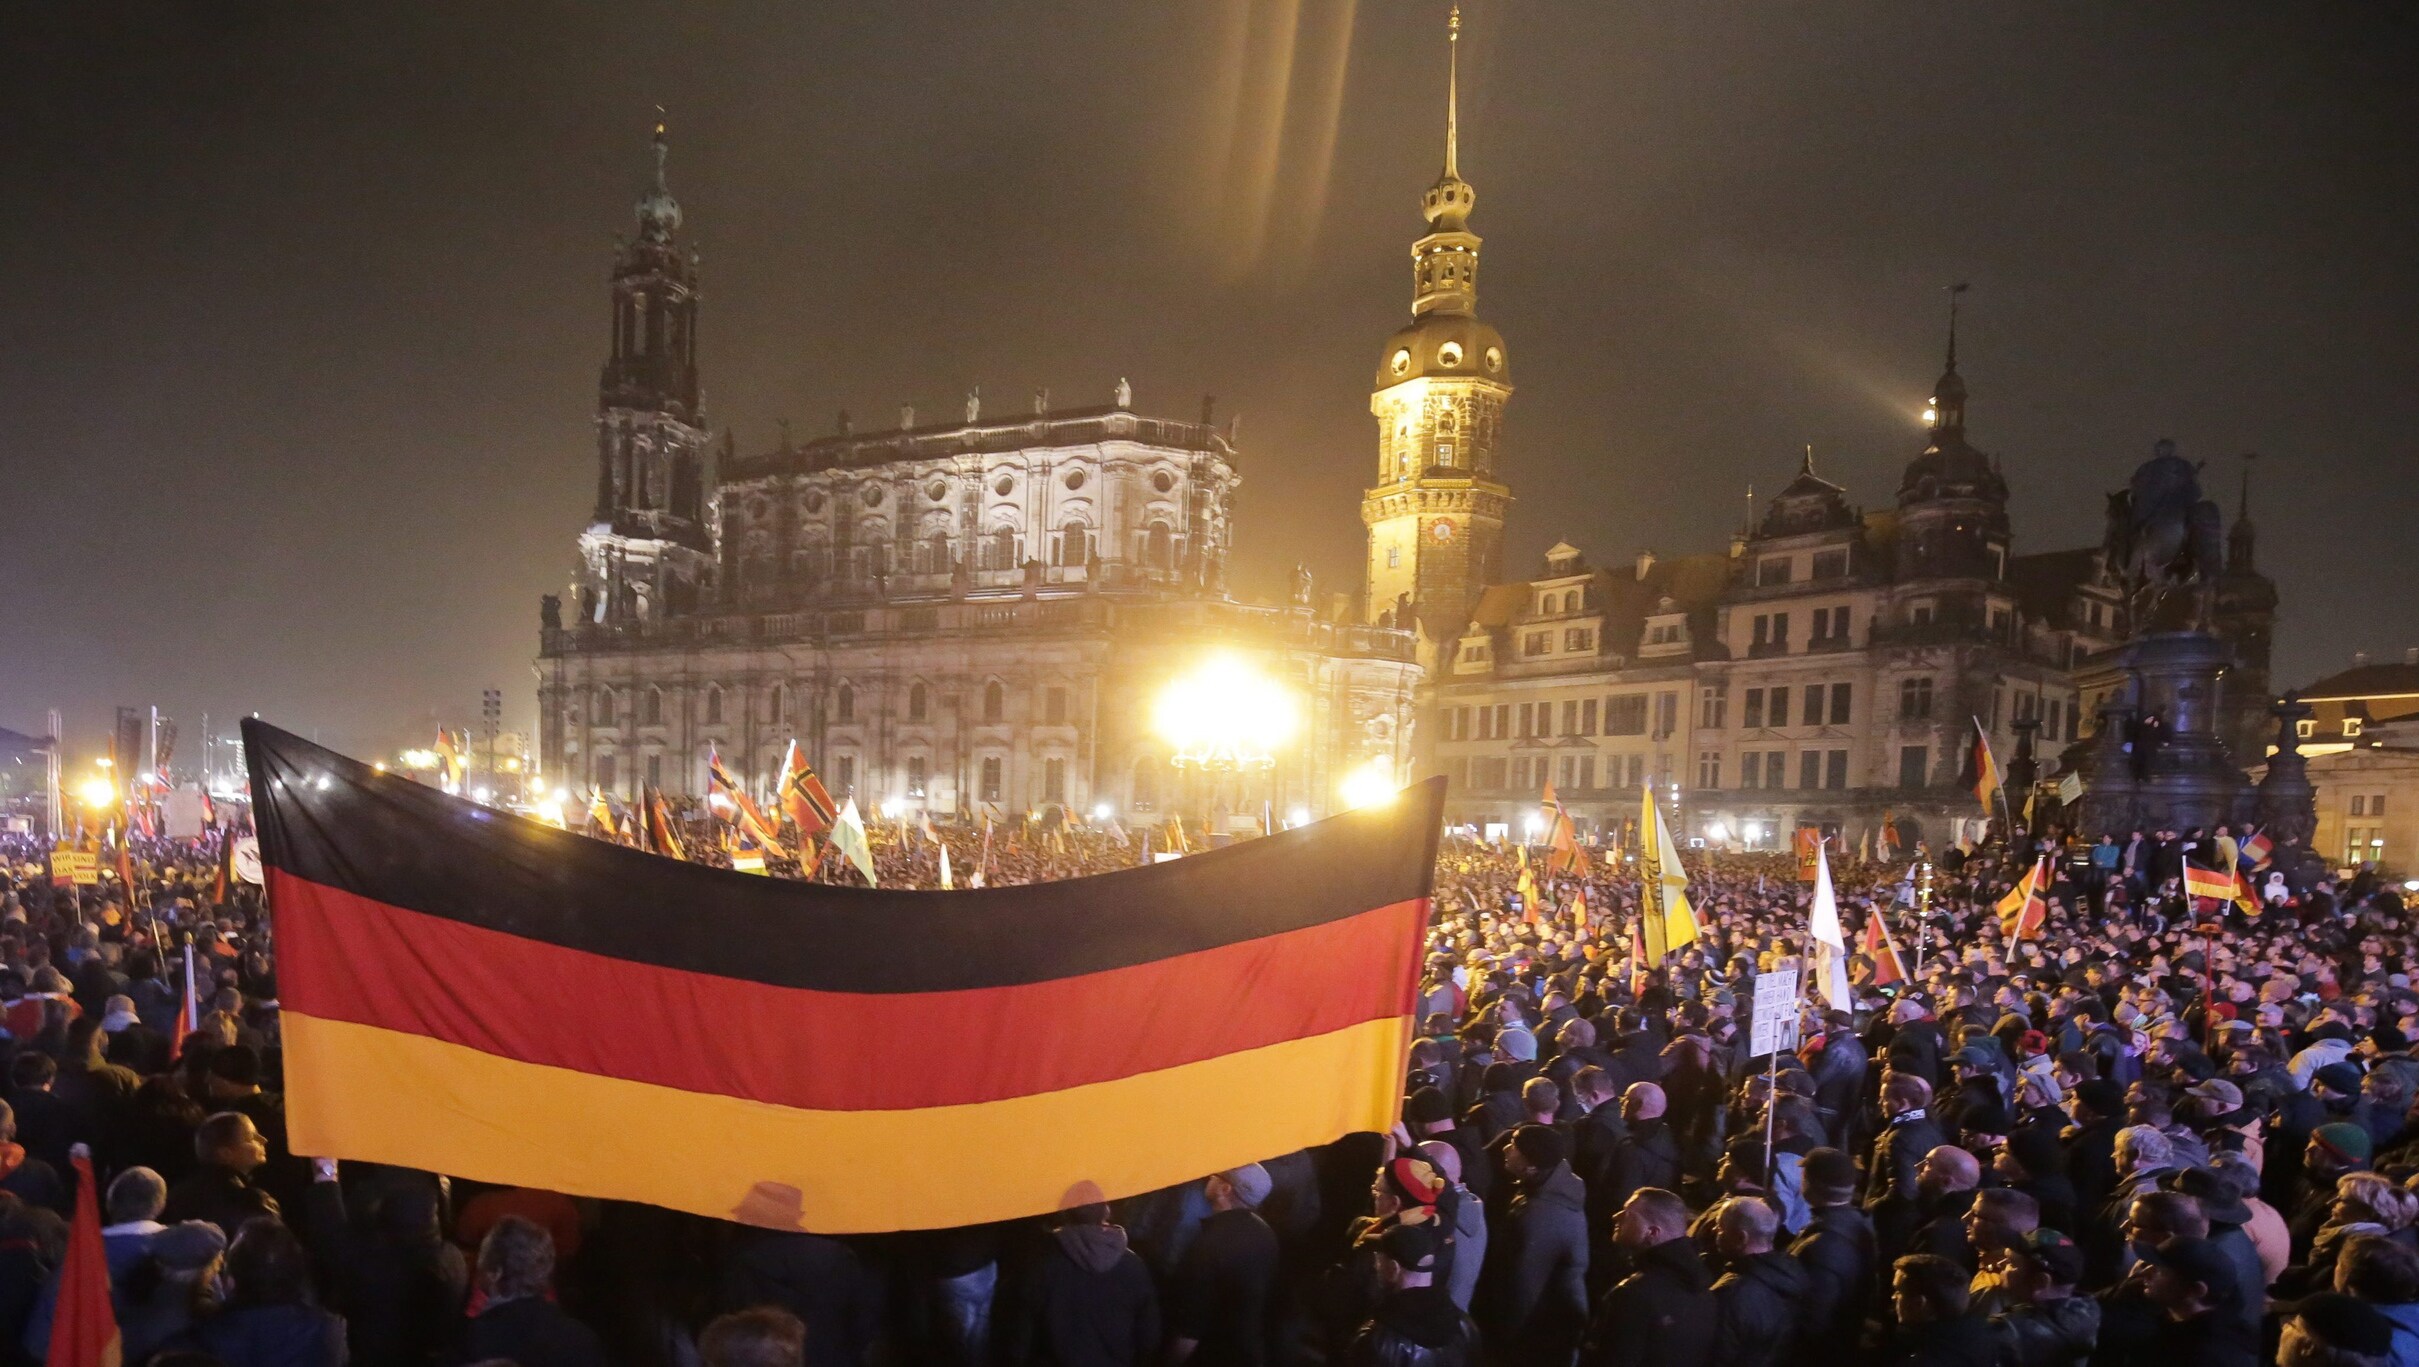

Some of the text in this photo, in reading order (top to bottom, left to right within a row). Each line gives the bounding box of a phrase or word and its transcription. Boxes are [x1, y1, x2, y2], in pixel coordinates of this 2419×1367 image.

[52, 854, 95, 863] WIR SIND
[54, 866, 73, 874] DAS
[74, 872, 96, 880] VOLK
